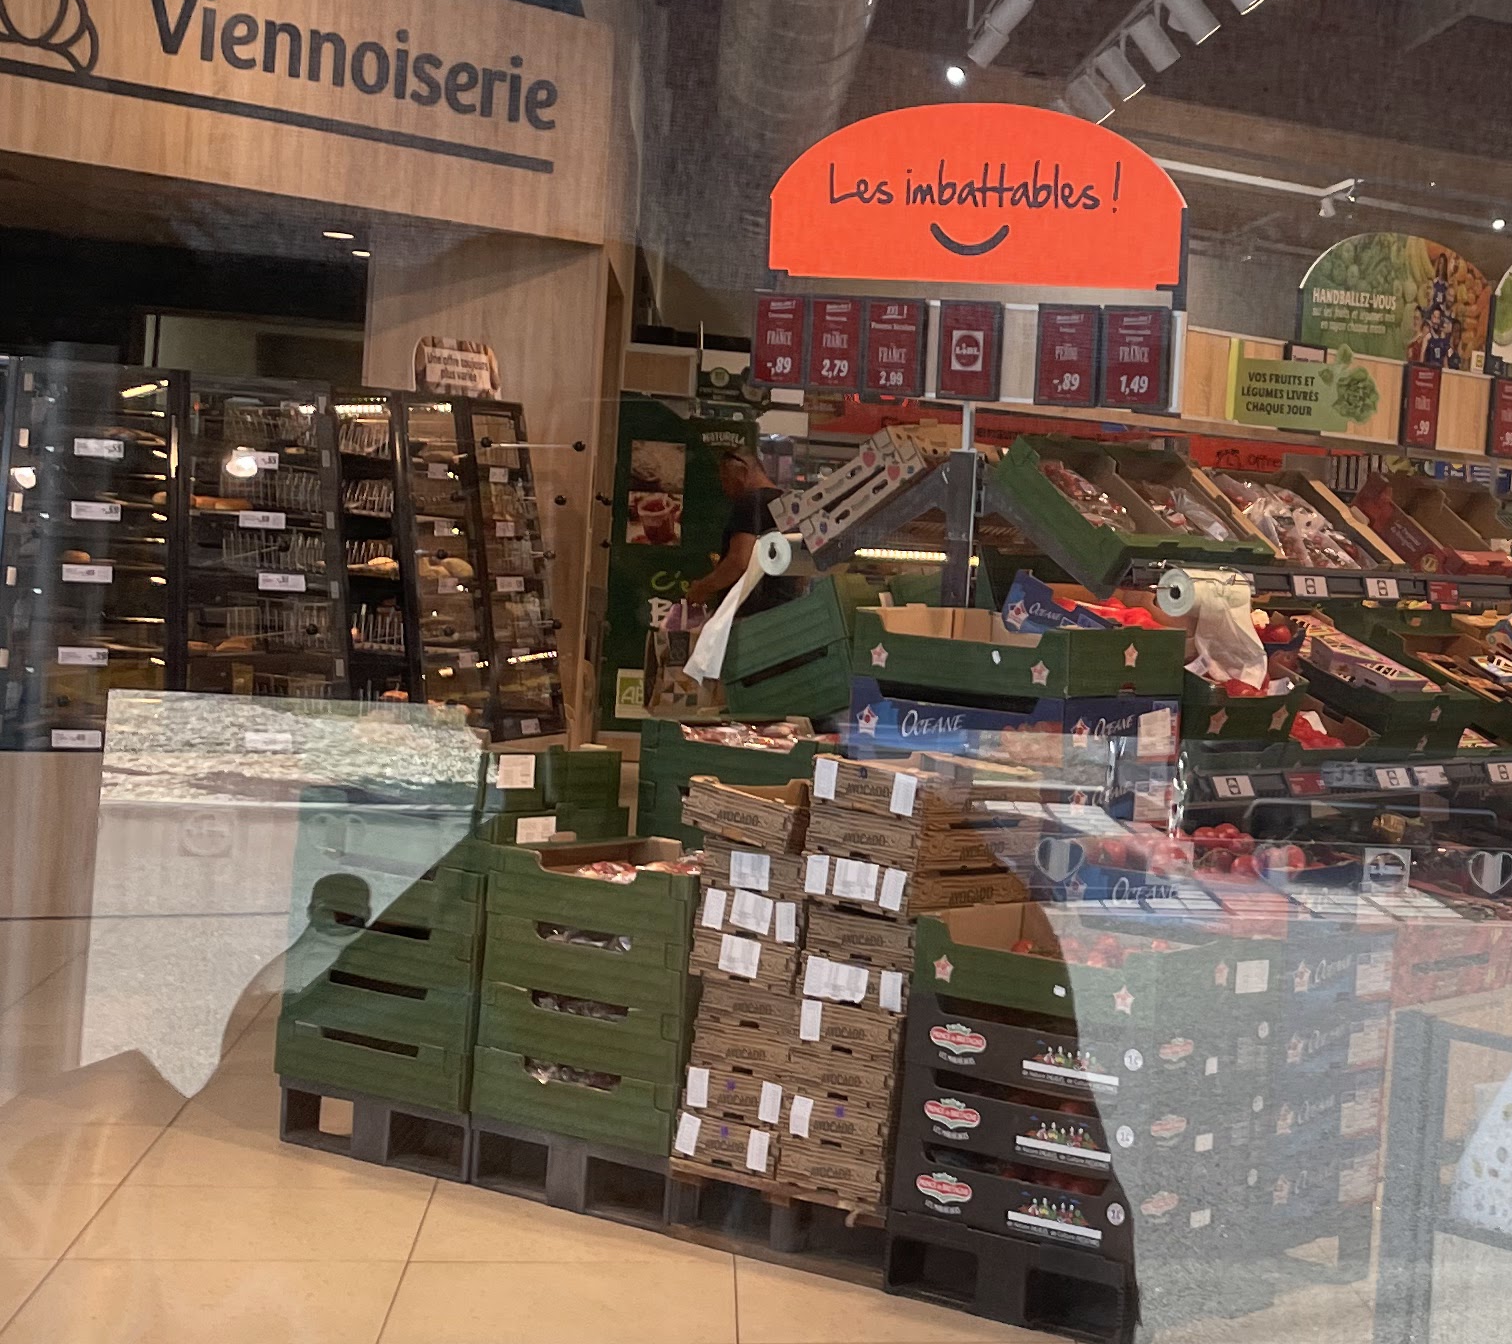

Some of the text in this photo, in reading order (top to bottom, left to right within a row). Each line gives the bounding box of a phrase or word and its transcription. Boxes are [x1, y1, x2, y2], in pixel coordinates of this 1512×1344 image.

[829, 159, 1121, 213] Les imbattables !
[1312, 287, 1397, 310] HANDBALLEZ-VOUS
[766, 330, 793, 346] FRANCE
[822, 333, 849, 349] FRANCE
[878, 347, 906, 364] FRANCE
[1119, 347, 1149, 363] FRANCE
[821, 359, 849, 378] 2,79
[1119, 375, 1149, 395] 1,49
[1248, 372, 1316, 387] VOS FRUITS ET
[1241, 384, 1320, 402] LÉGUMES LIVRÉS
[1245, 401, 1312, 417] CHAQUE JOUR
[901, 709, 967, 738] OCEANE
